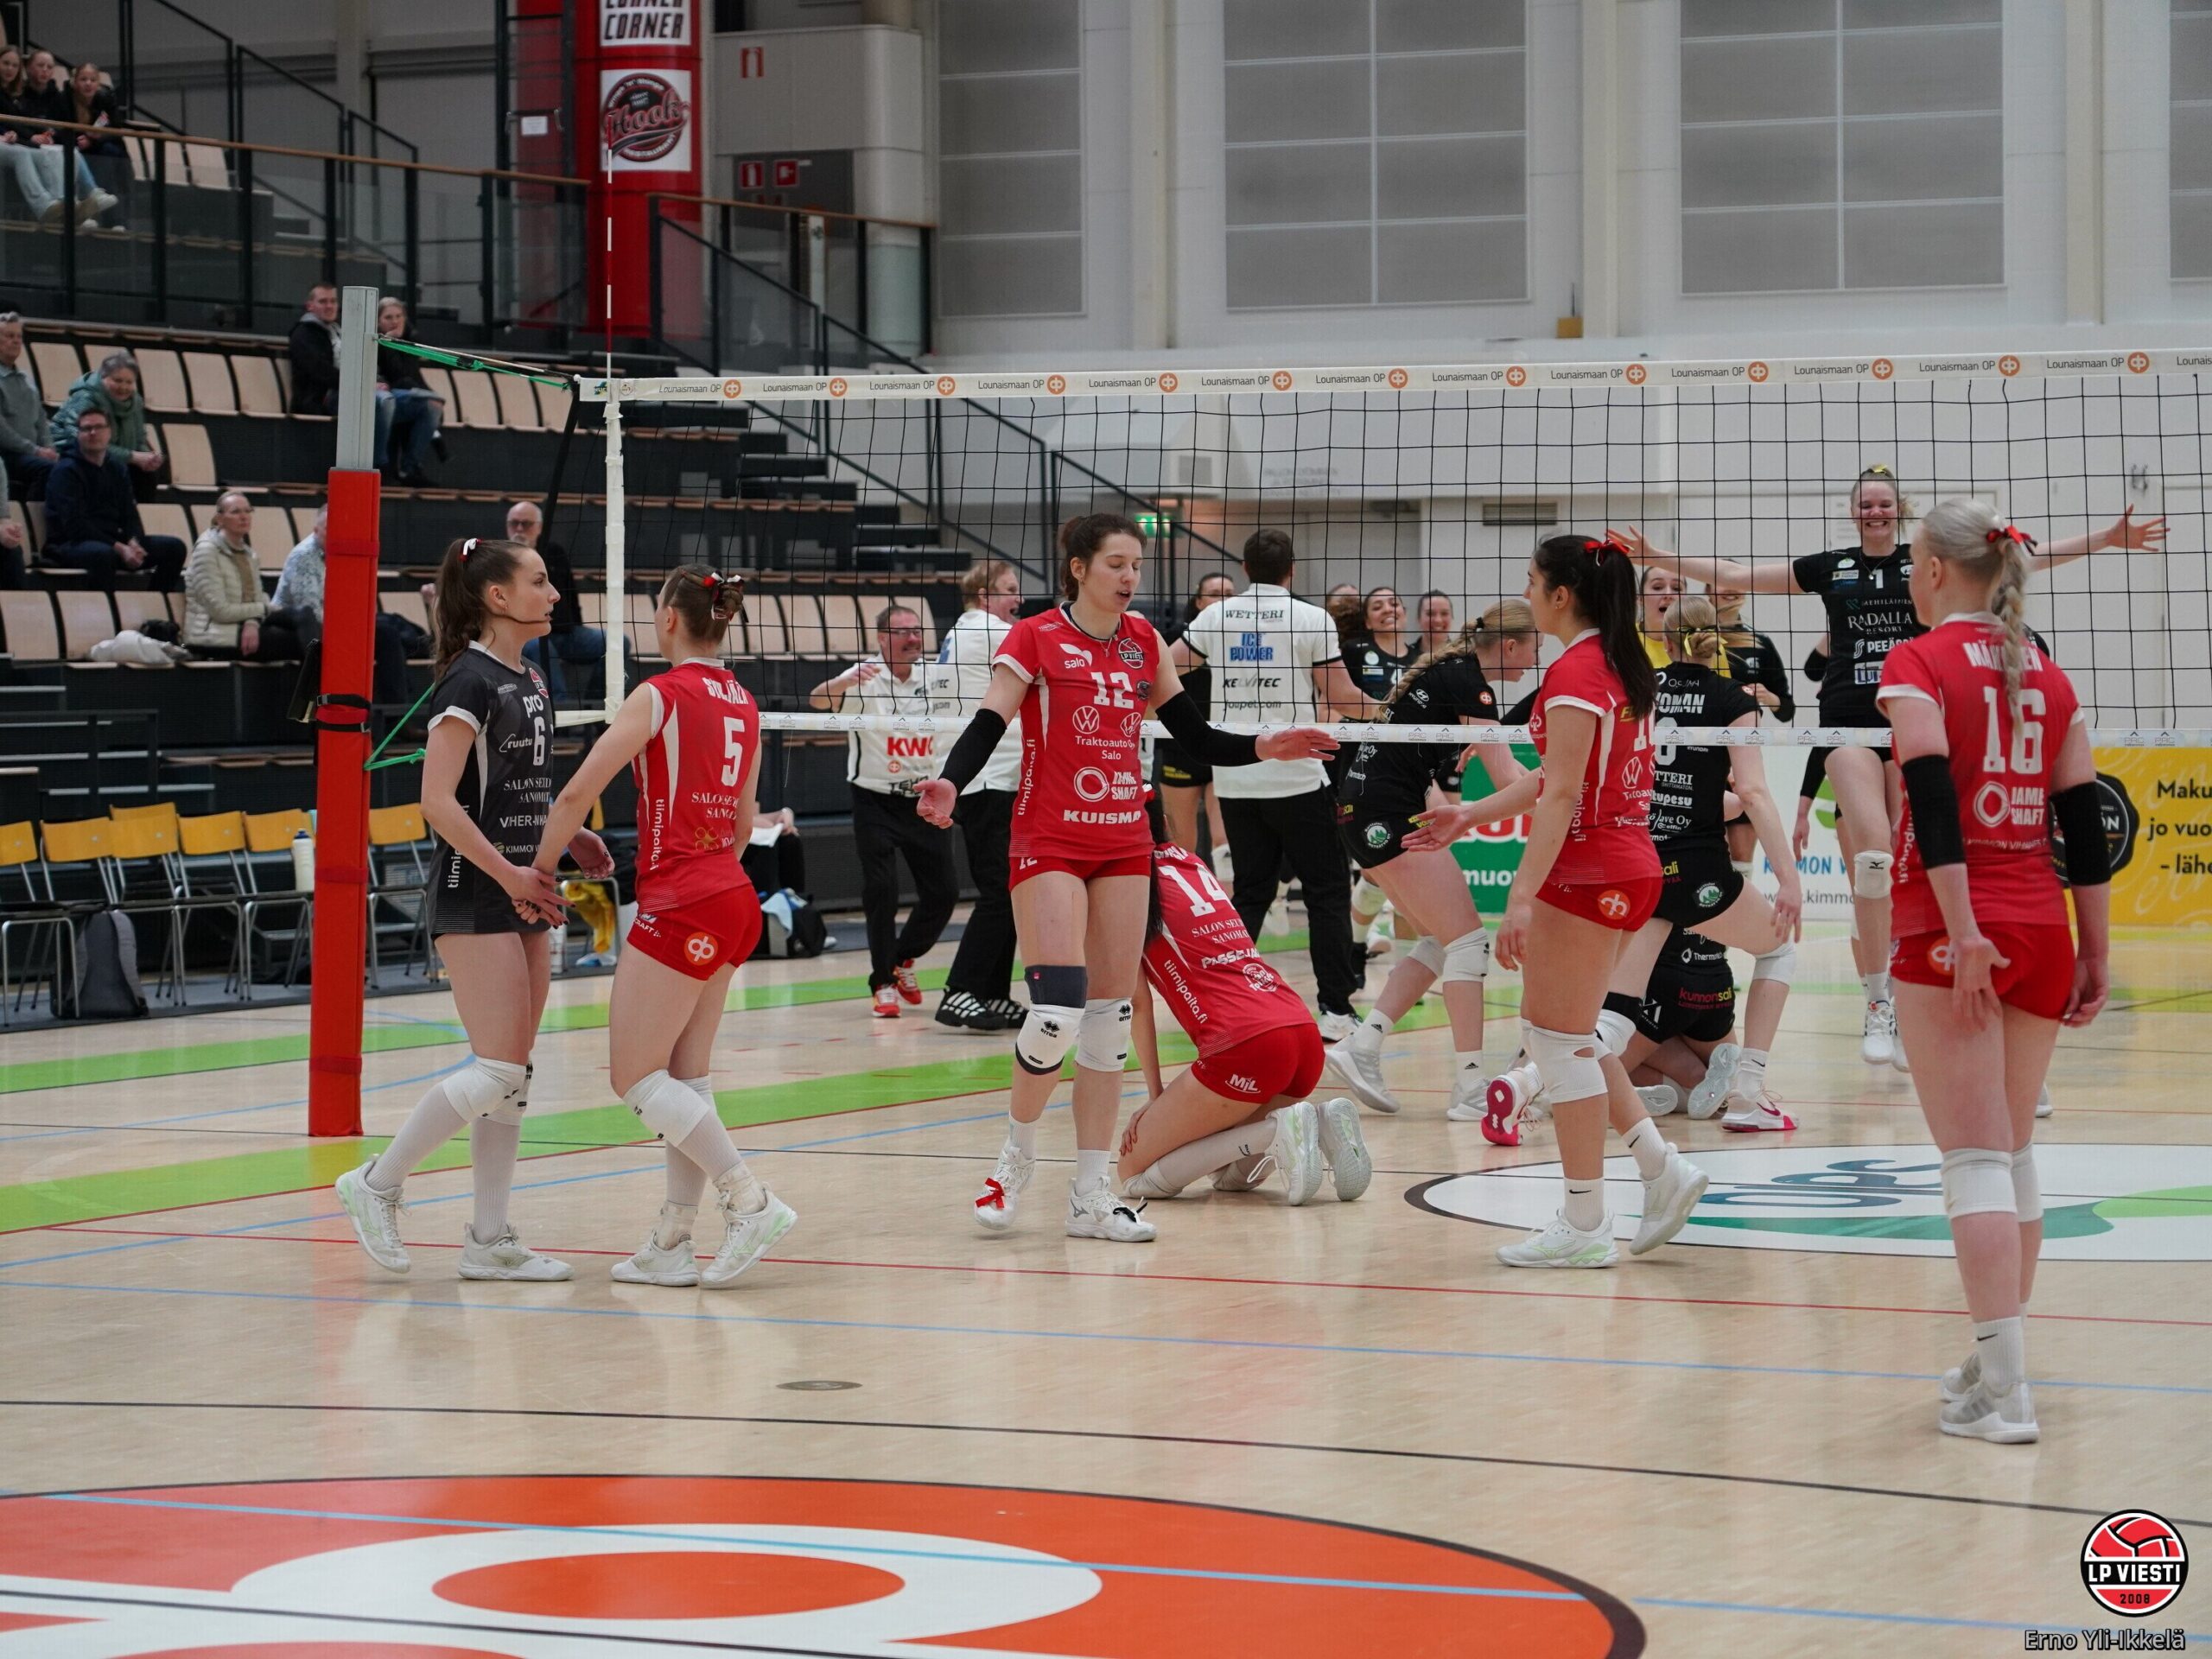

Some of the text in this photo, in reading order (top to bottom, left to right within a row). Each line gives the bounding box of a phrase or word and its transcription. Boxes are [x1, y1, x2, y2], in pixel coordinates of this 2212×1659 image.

[604, 12, 683, 41] CORNER
[1795, 364, 1870, 375] Lounaismaan OP
[1920, 361, 1996, 372] Lounaismaan OP
[2047, 358, 2125, 369] Lounaismaan OP
[1316, 373, 1386, 384] Lounaismaan OP
[1433, 372, 1503, 382] Lounaismaan OP
[1551, 369, 1624, 379] Lounaismaan OP
[1672, 366, 1745, 378] Lounaismaan OP
[763, 382, 827, 392] Lounaismaan OP
[869, 380, 935, 391] Lounaismaan OP
[978, 379, 1045, 390] Lounaismaan OP
[1089, 378, 1156, 388] Lounaismaan OP
[1202, 376, 1270, 386] Lounaismaan OP
[658, 384, 721, 394] Lounaismaan OP
[1872, 569, 1884, 589] 1
[1225, 609, 1285, 620] WETTERI
[1847, 611, 1913, 631] RADALLA
[1242, 632, 1263, 647] ICE
[1230, 646, 1274, 661] POWER
[1065, 658, 1085, 669] salo
[1090, 671, 1135, 709] 12
[523, 694, 543, 719] pro
[1983, 686, 2046, 774] 16
[507, 738, 533, 749] ruutu
[533, 716, 546, 766] 6
[1075, 735, 1128, 747] Traktoauto
[721, 716, 745, 787] 5
[1102, 750, 1122, 760] Salo
[504, 778, 534, 791] SALON
[2157, 779, 2212, 798] Maku
[2012, 786, 2044, 805] JAME
[1676, 815, 1693, 829] Oy
[2012, 807, 2044, 825] SHAFT
[2147, 817, 2212, 842] jo vuo
[2176, 854, 2212, 874] lähe
[1158, 862, 1236, 918] 14
[1191, 921, 1225, 938] SALON
[1163, 959, 1209, 1024] tiimipaita.fi
